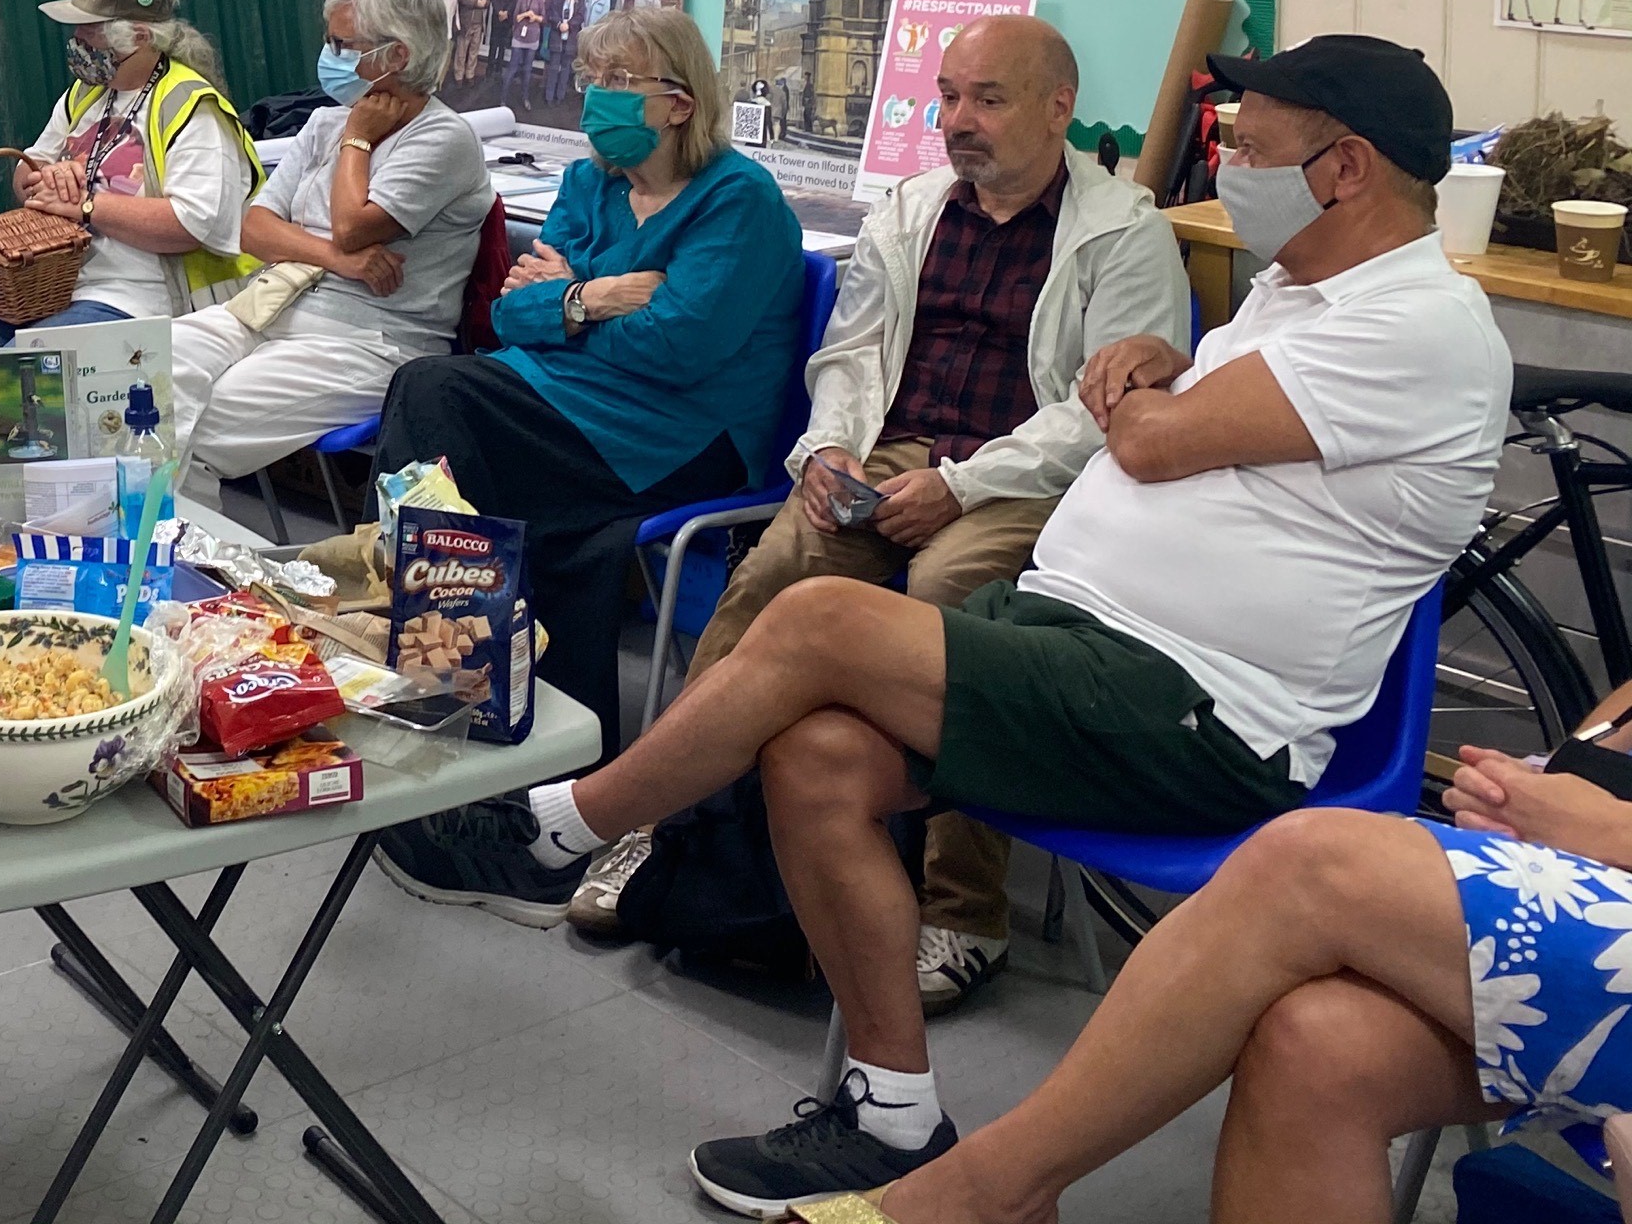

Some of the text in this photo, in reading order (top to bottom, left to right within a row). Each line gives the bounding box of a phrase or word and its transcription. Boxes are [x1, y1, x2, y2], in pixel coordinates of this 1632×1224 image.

[536, 133, 551, 142] and
[552, 135, 588, 148] informatio
[752, 151, 776, 164] Clock
[778, 154, 805, 167] Tower
[808, 161, 819, 170] on
[822, 160, 846, 173] Ilford
[777, 170, 803, 185] being
[805, 178, 837, 188] moved
[839, 180, 848, 189] to
[86, 390, 129, 404] Garde
[427, 533, 489, 553] BALOCCO
[404, 559, 496, 593] Cubes
[116, 583, 160, 604] PDS
[429, 586, 475, 600] Cocoa
[437, 598, 469, 610] Wafers
